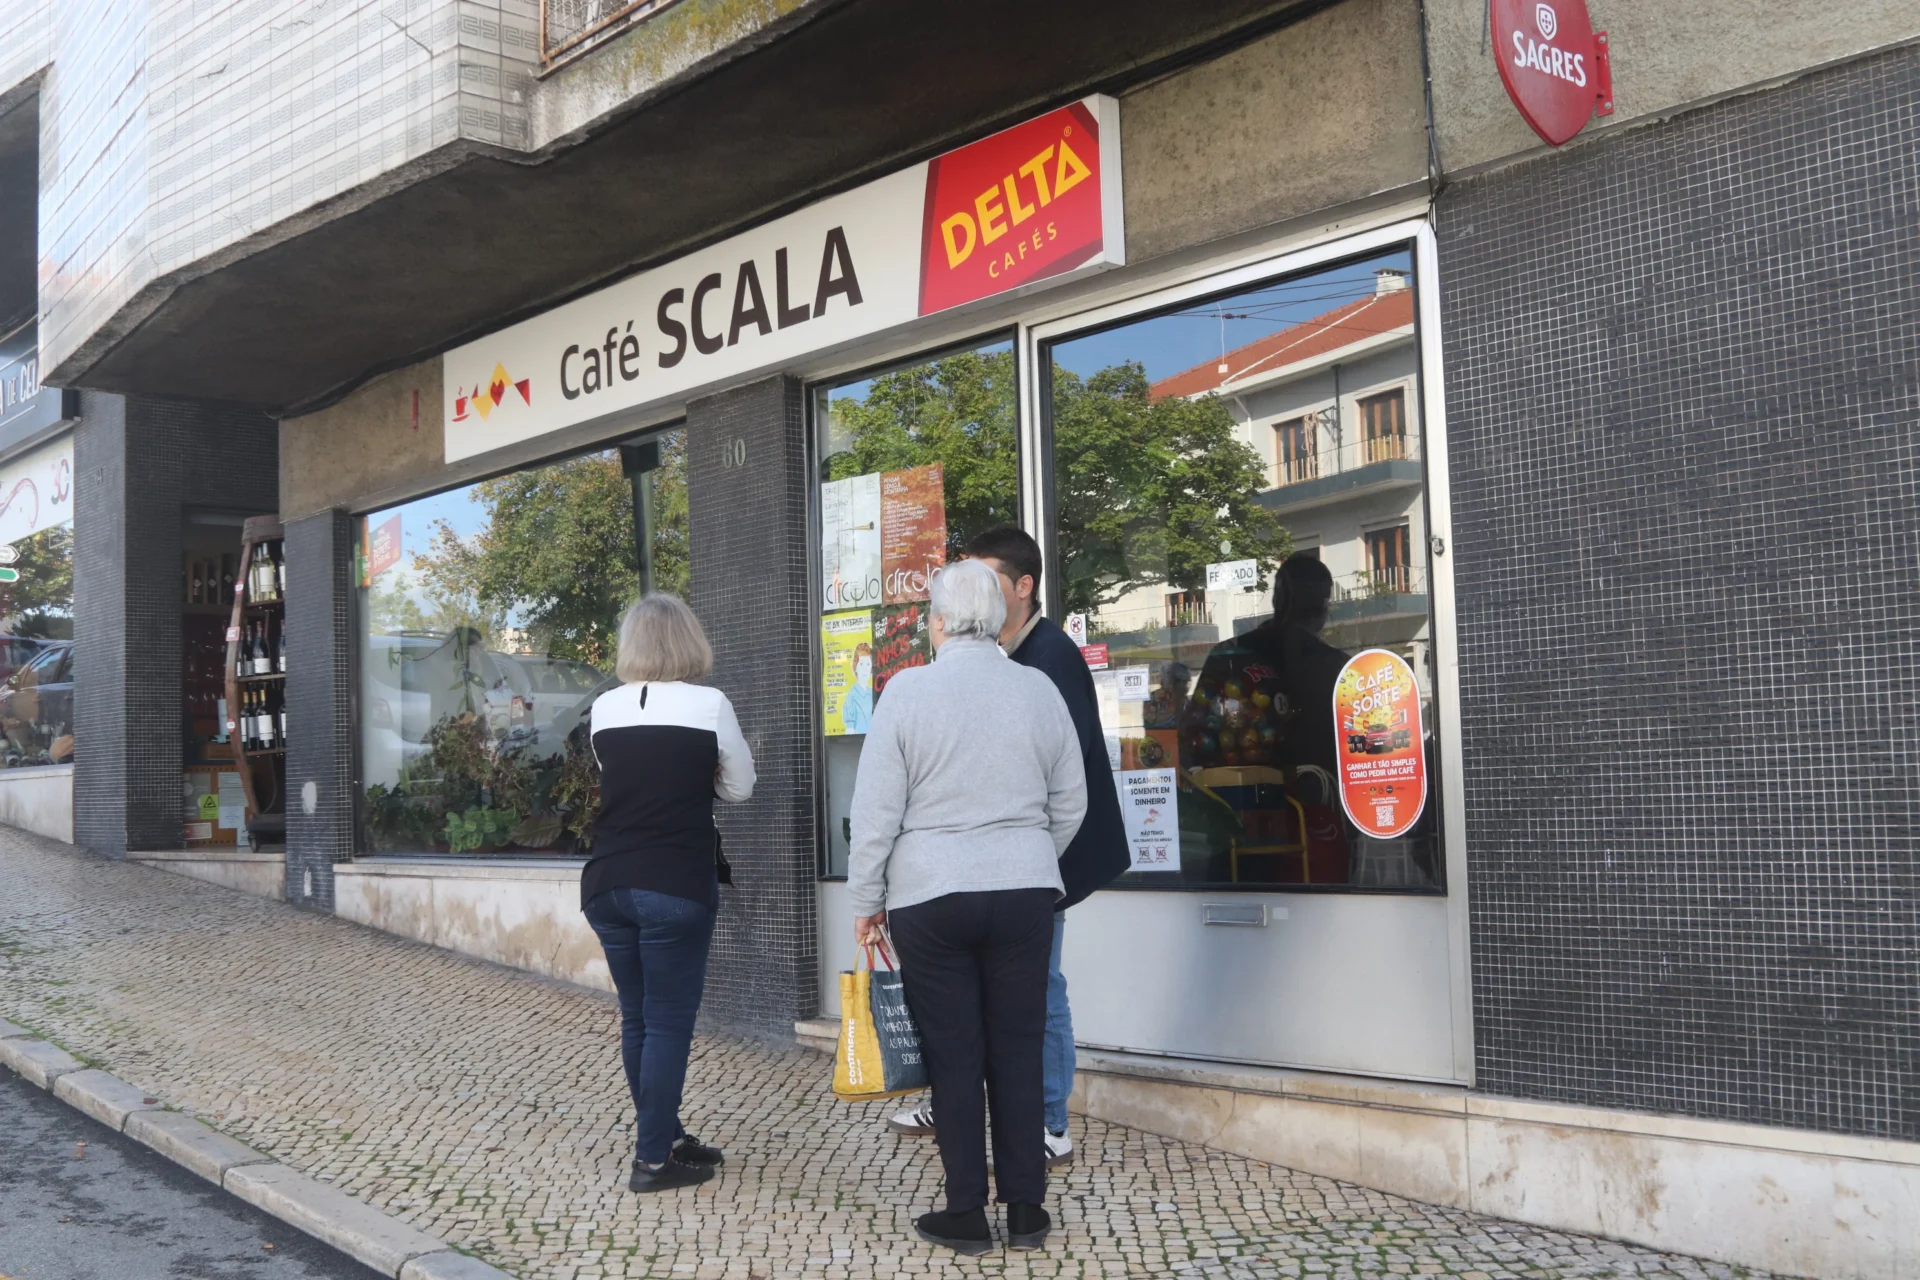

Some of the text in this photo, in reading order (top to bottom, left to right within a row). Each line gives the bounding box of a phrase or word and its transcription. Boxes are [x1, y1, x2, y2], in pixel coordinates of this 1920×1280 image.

[1513, 30, 1587, 88] SAGRES
[941, 139, 1092, 270] DELTA
[988, 222, 1057, 278] CAFÉS
[560, 226, 863, 401] Café SCALA
[7, 377, 17, 407] DE
[723, 438, 746, 469] 60
[1355, 661, 1394, 692] CAFÉ
[1353, 685, 1401, 716] SORTE
[1346, 757, 1417, 771] GANHAR É TÃO SIMPLES
[1350, 766, 1415, 779] COMO PEDIR UM CAFÉ
[1128, 775, 1172, 785] PAGAMENTOS
[1130, 786, 1170, 795] SOMENTE EM
[1135, 797, 1167, 806] DINHEIRO
